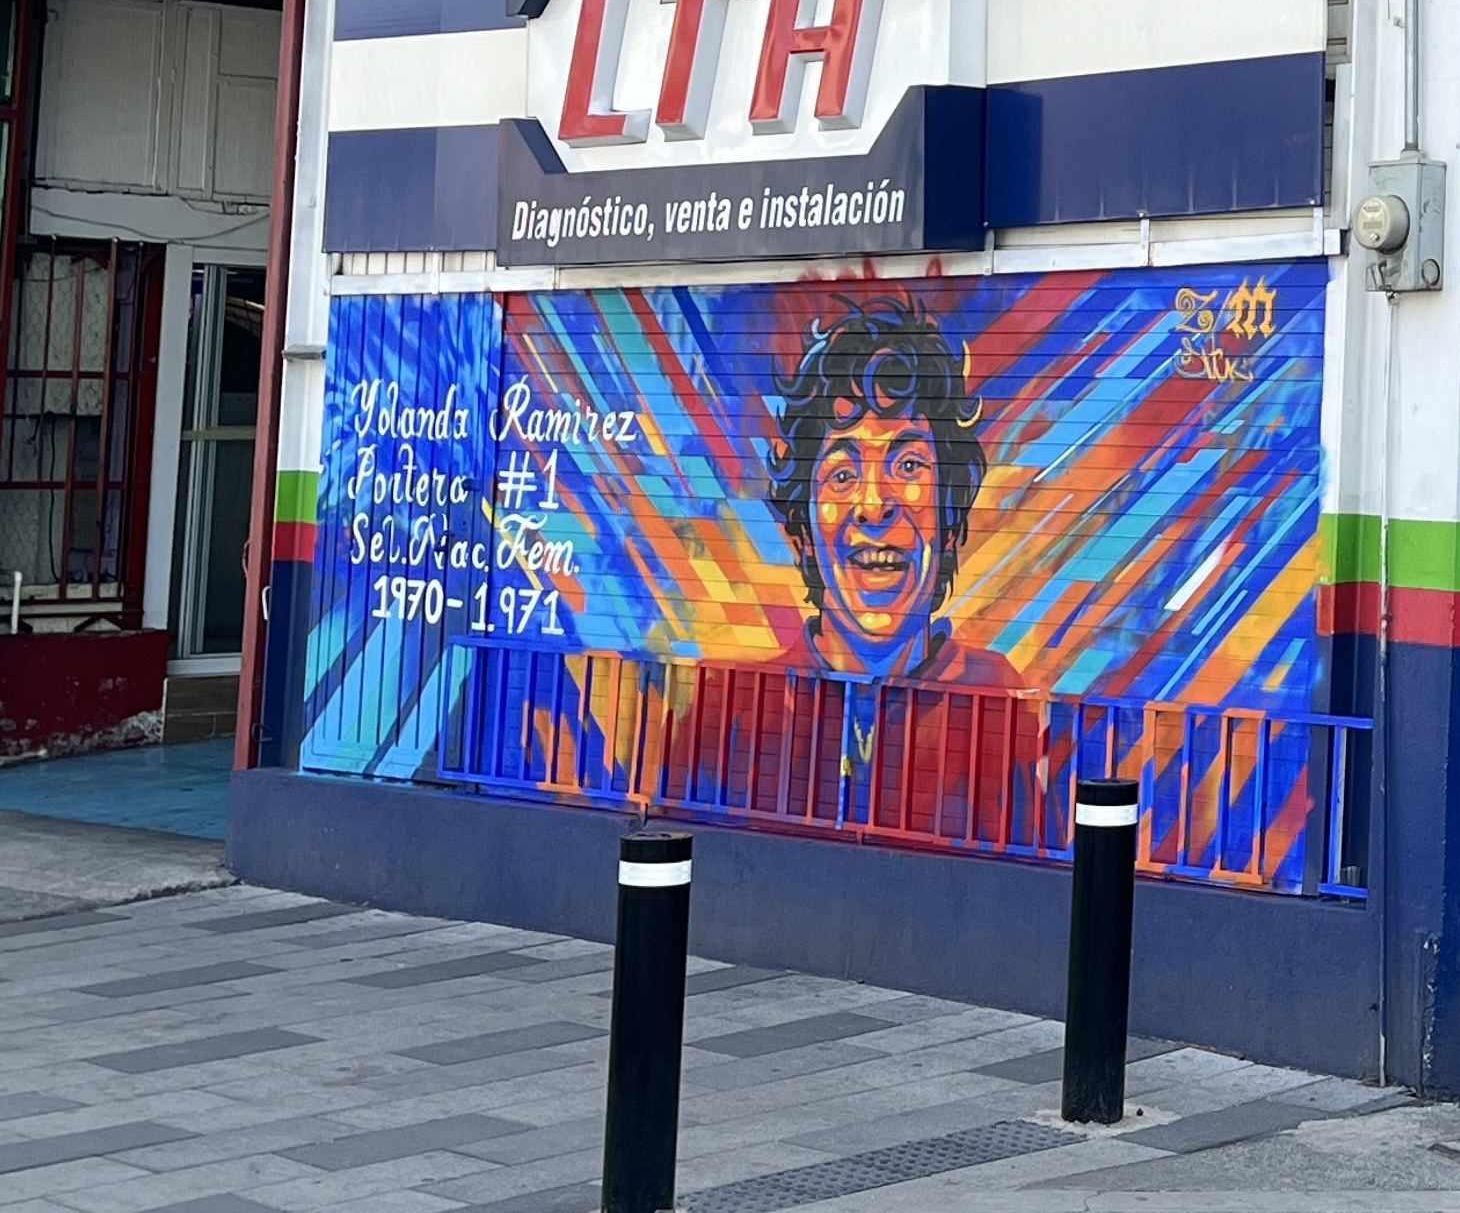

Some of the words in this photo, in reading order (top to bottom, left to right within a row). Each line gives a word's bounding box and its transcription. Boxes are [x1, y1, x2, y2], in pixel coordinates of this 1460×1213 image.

[511, 193, 655, 249] Diagnóstico,
[664, 193, 731, 235] venta
[738, 198, 752, 231] e
[760, 178, 906, 229] instalación
[350, 377, 469, 442] Yolanda
[489, 375, 638, 447] Ramirez
[348, 442, 469, 507] Portera
[497, 449, 561, 511] #1
